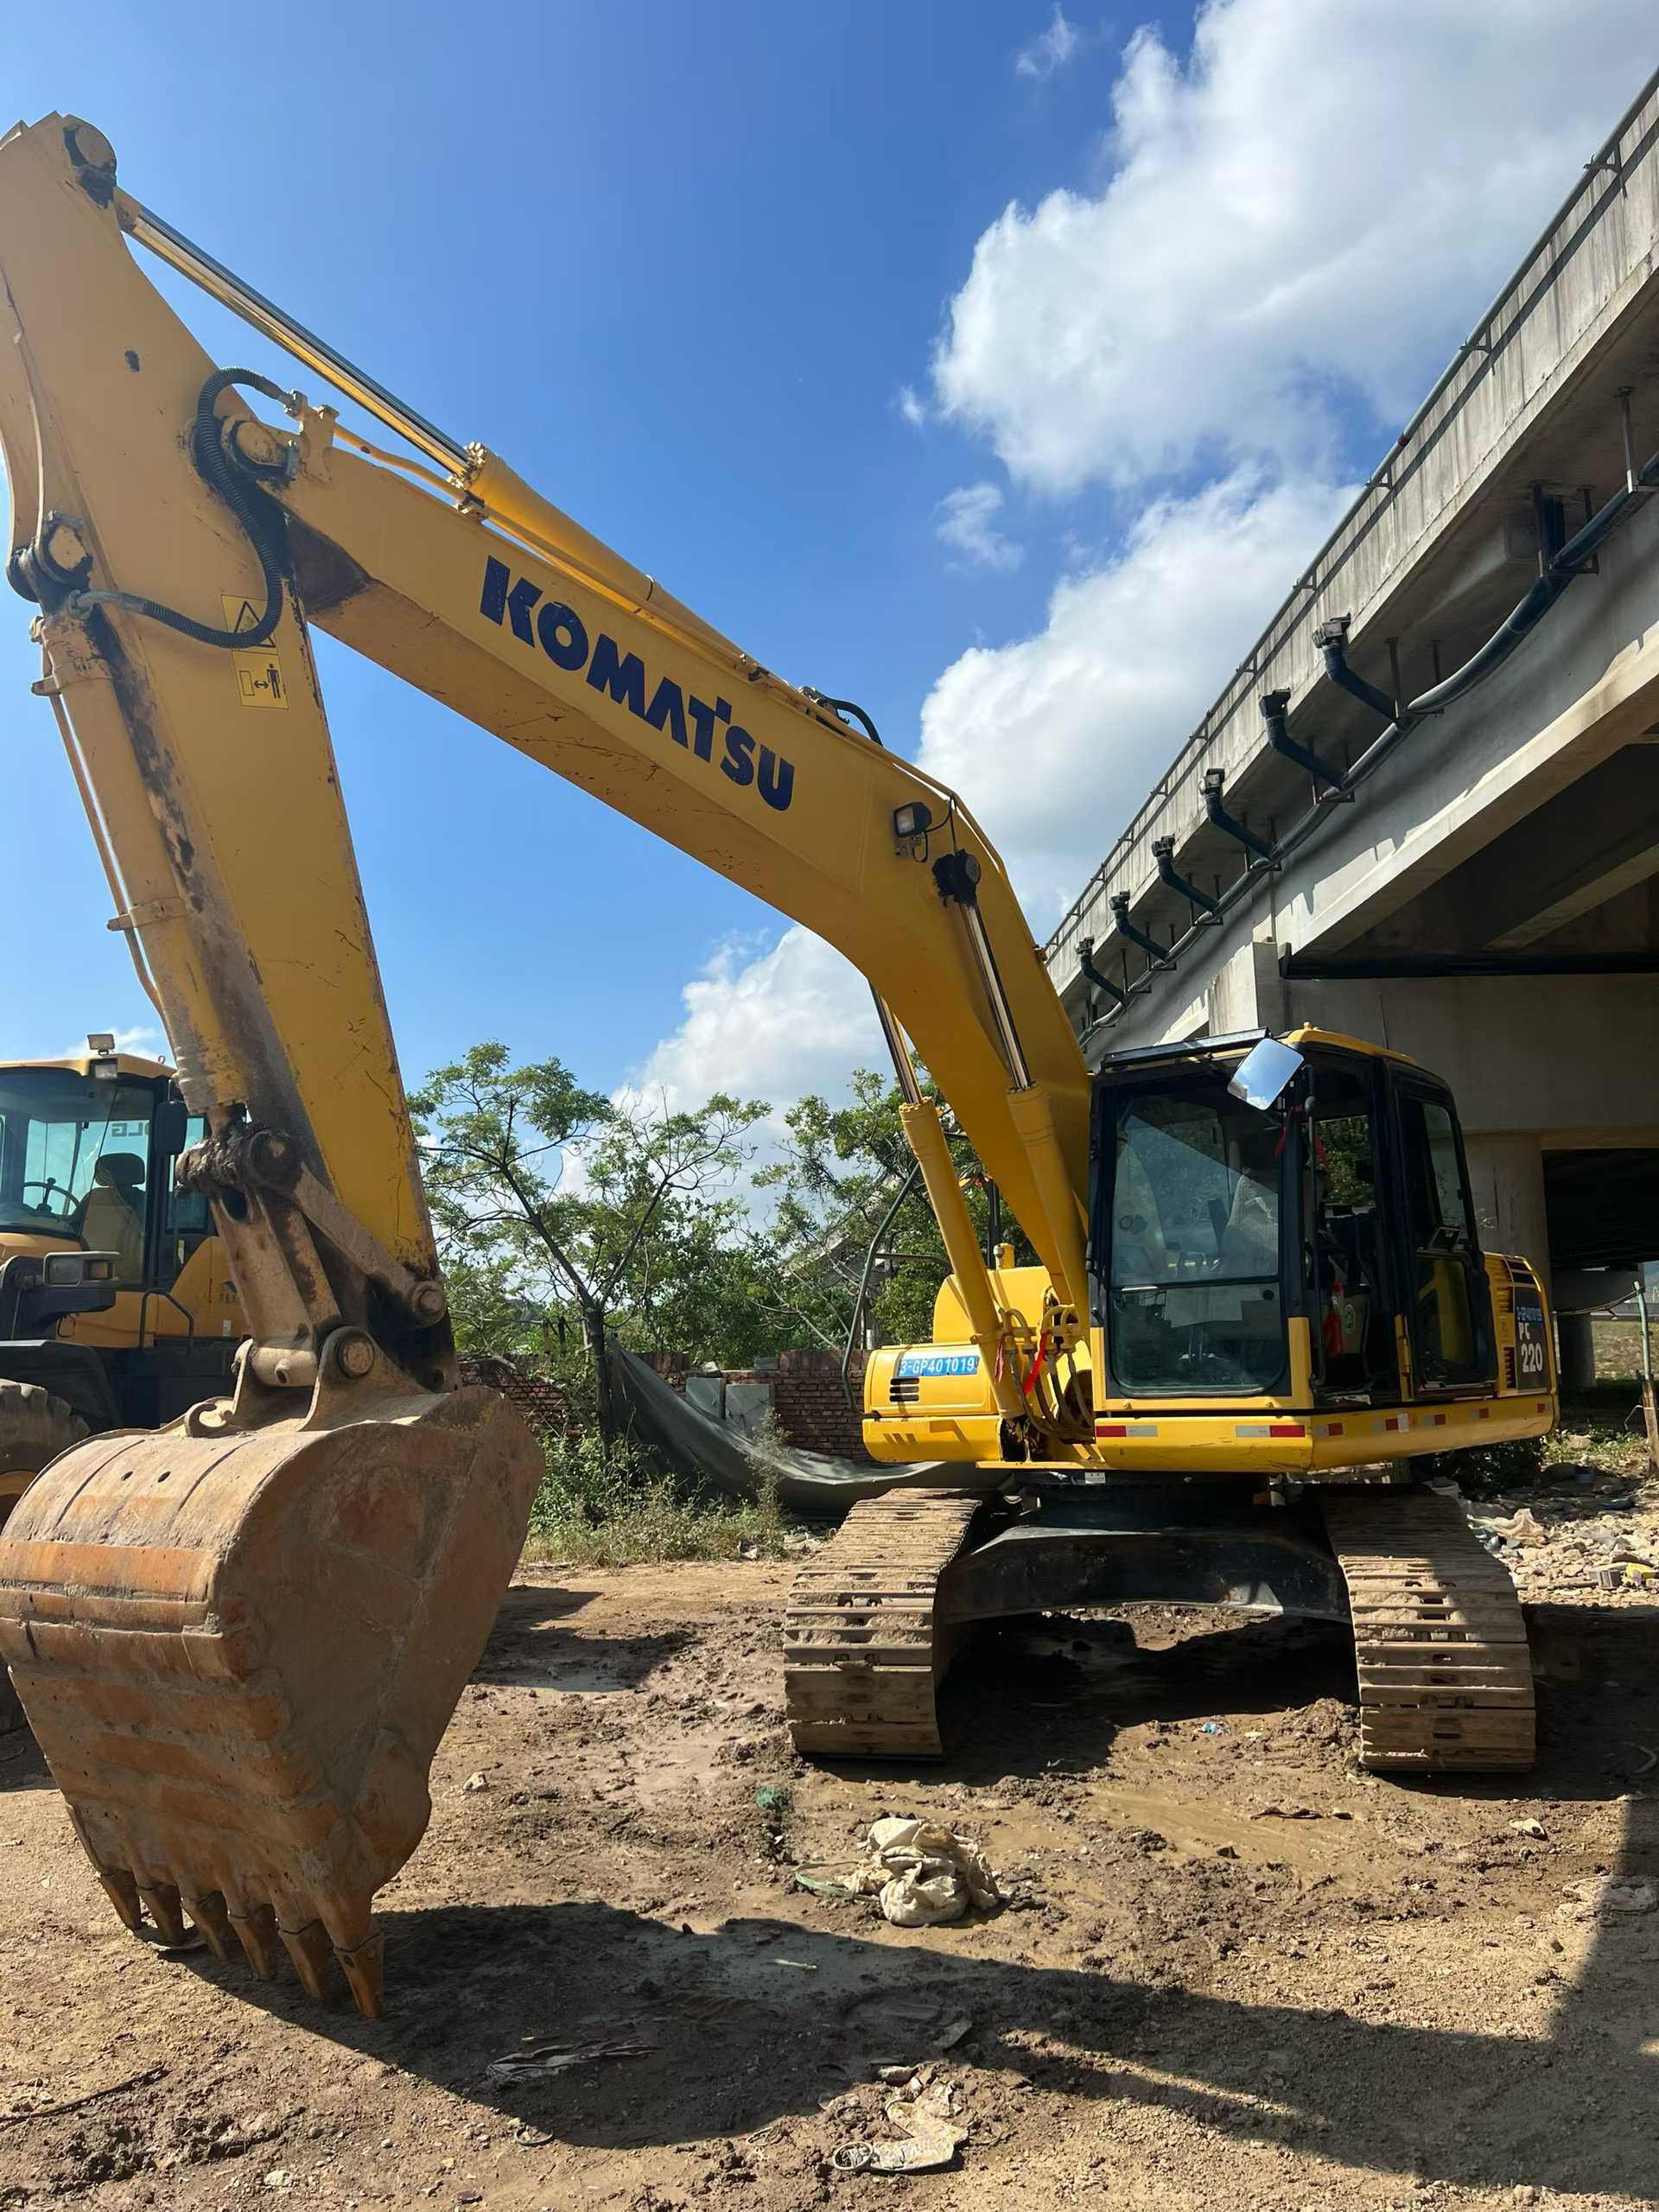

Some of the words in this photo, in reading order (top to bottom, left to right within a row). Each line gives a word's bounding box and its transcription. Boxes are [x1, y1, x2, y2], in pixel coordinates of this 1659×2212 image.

[480, 555, 795, 811] KOMATSU
[1518, 1322, 1530, 1340] PC
[1521, 1342, 1543, 1372] 220
